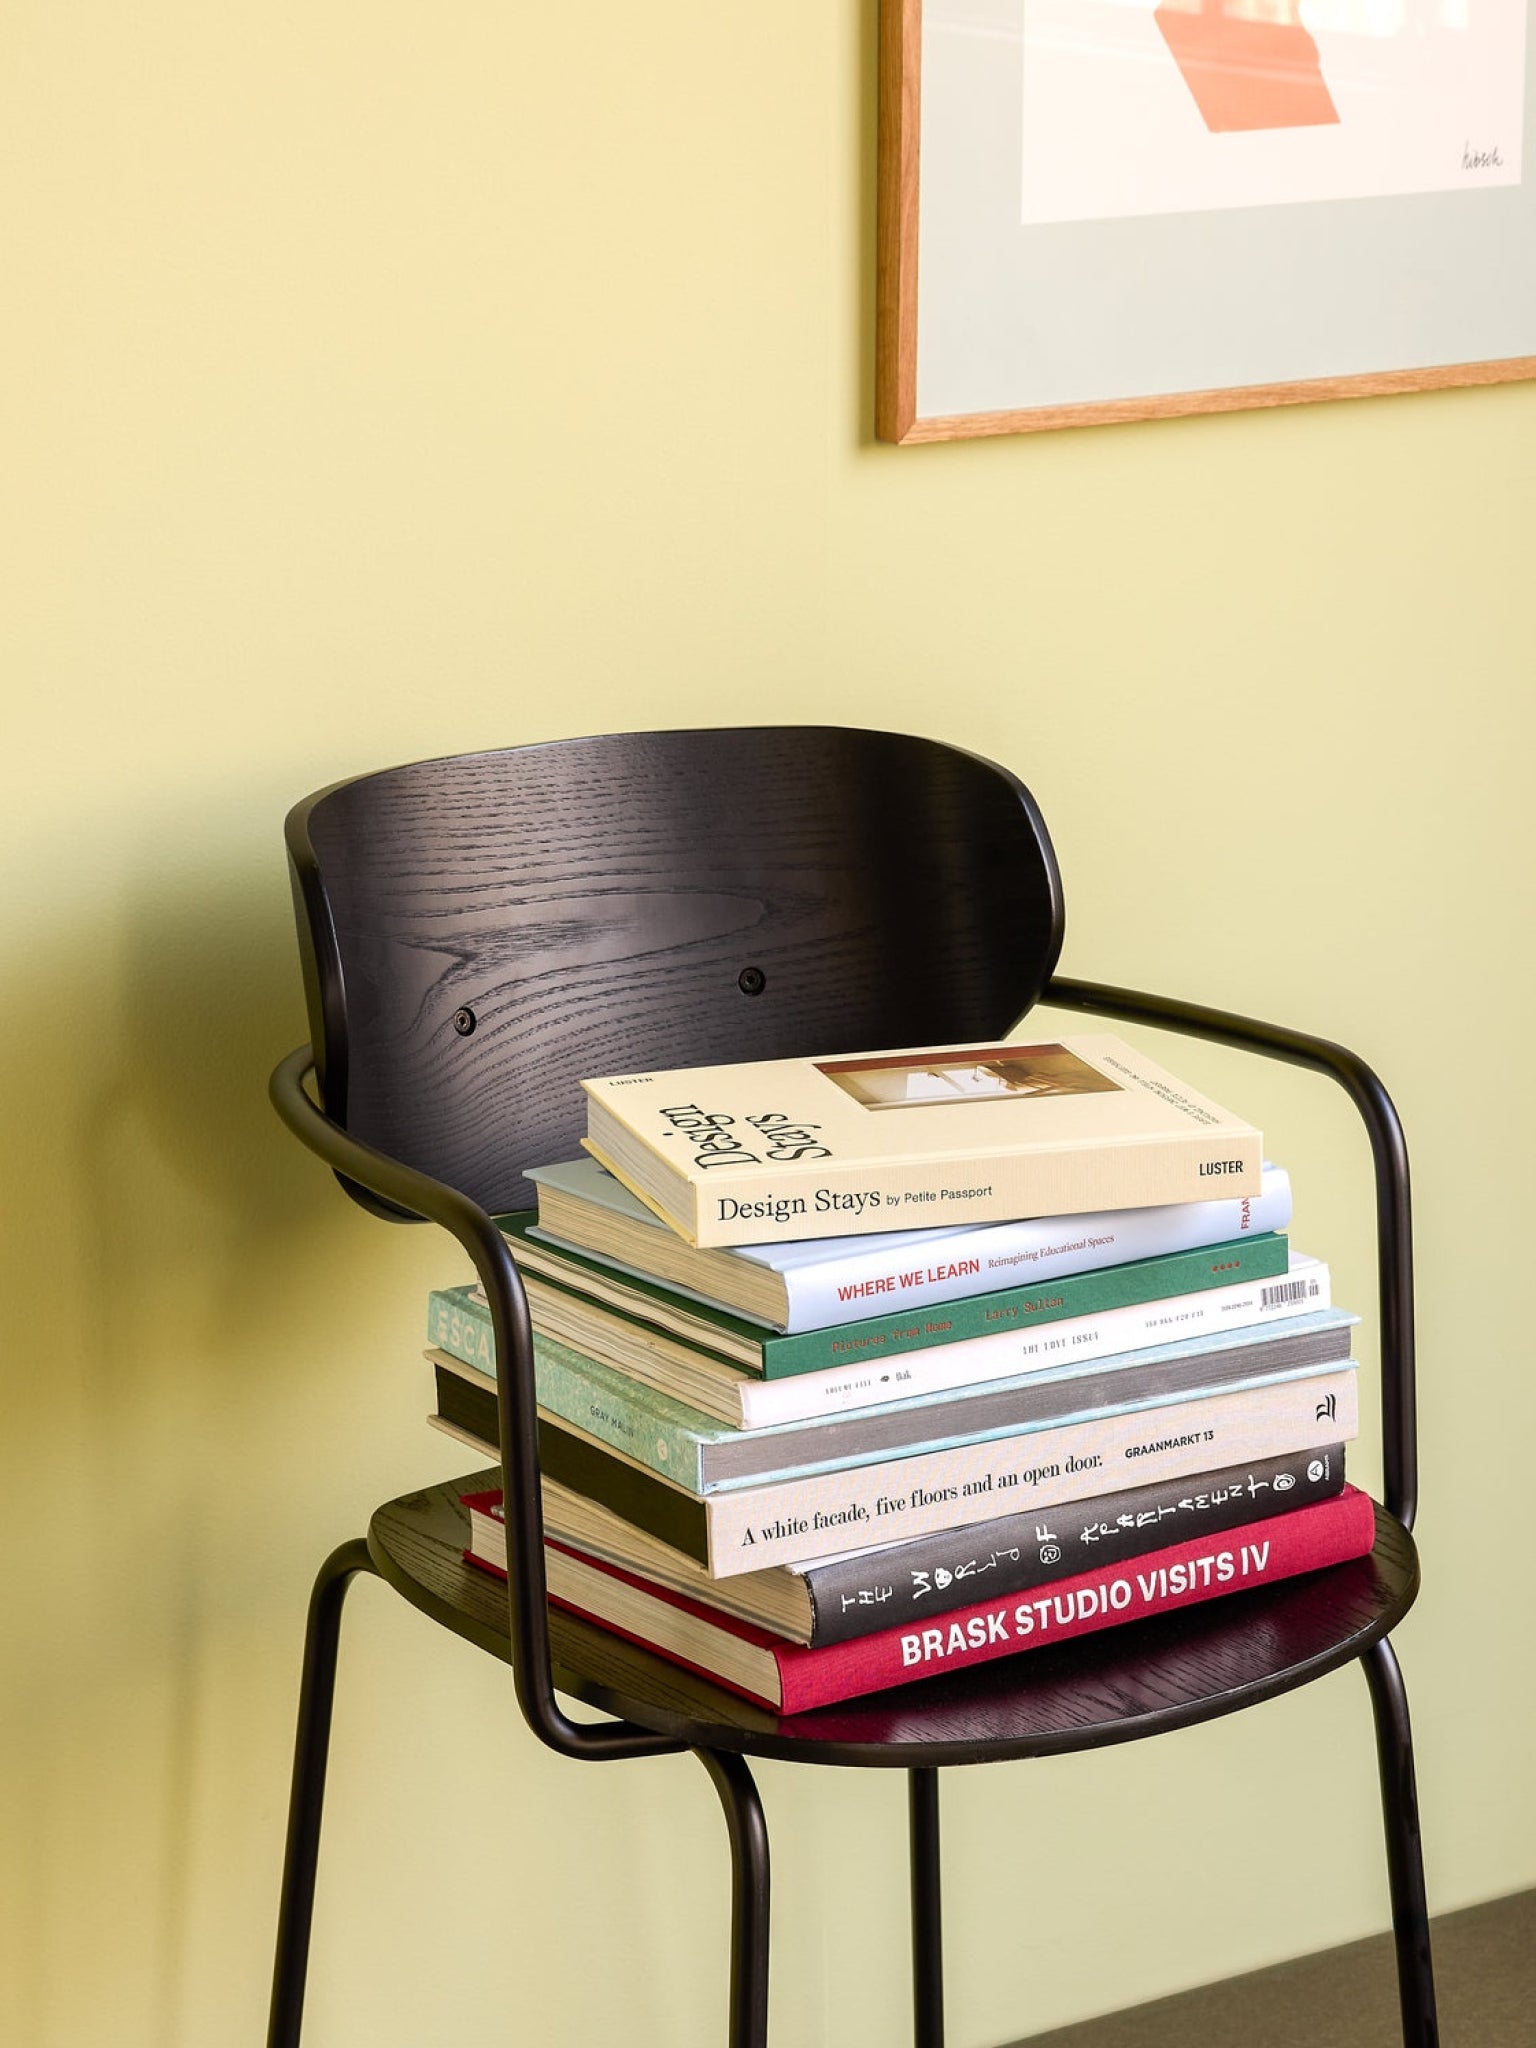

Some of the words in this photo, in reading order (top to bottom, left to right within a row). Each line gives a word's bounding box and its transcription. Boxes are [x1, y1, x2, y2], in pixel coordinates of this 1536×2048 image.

[608, 1076, 655, 1087] LUSTER
[659, 1104, 762, 1170] Design
[745, 1112, 833, 1161] Stays
[1199, 1160, 1244, 1177] LUSTER
[717, 1194, 808, 1223] Design
[815, 1188, 881, 1216] Stays
[886, 1194, 900, 1206] by
[904, 1190, 937, 1203] Petite
[941, 1185, 993, 1201] Passport
[987, 1250, 1039, 1269] Reimagining
[1039, 1238, 1087, 1259] Educational
[1088, 1233, 1115, 1250] Spaces
[838, 1275, 896, 1302] WHERE
[899, 1270, 925, 1290] WE
[928, 1258, 981, 1283] LEARN
[984, 1306, 1019, 1323] Larry
[832, 1334, 887, 1353] Pictures
[925, 1320, 953, 1334] Home
[590, 1404, 610, 1422] GRAY
[1125, 1433, 1201, 1459] GRAANMARKT
[1203, 1429, 1215, 1442] 13
[741, 1528, 756, 1547] A
[761, 1515, 808, 1543] white
[813, 1502, 871, 1529] facade,
[875, 1496, 906, 1517] five
[910, 1487, 959, 1510] floors
[962, 1474, 994, 1496] and
[998, 1473, 1018, 1489] an
[1023, 1463, 1061, 1489] open
[1065, 1453, 1104, 1477] door.
[840, 1585, 894, 1613] THE
[900, 1608, 1011, 1668] BRASK
[1015, 1580, 1132, 1640] STUDIO
[1135, 1549, 1235, 1603] VISITS
[1240, 1540, 1272, 1576] IV
